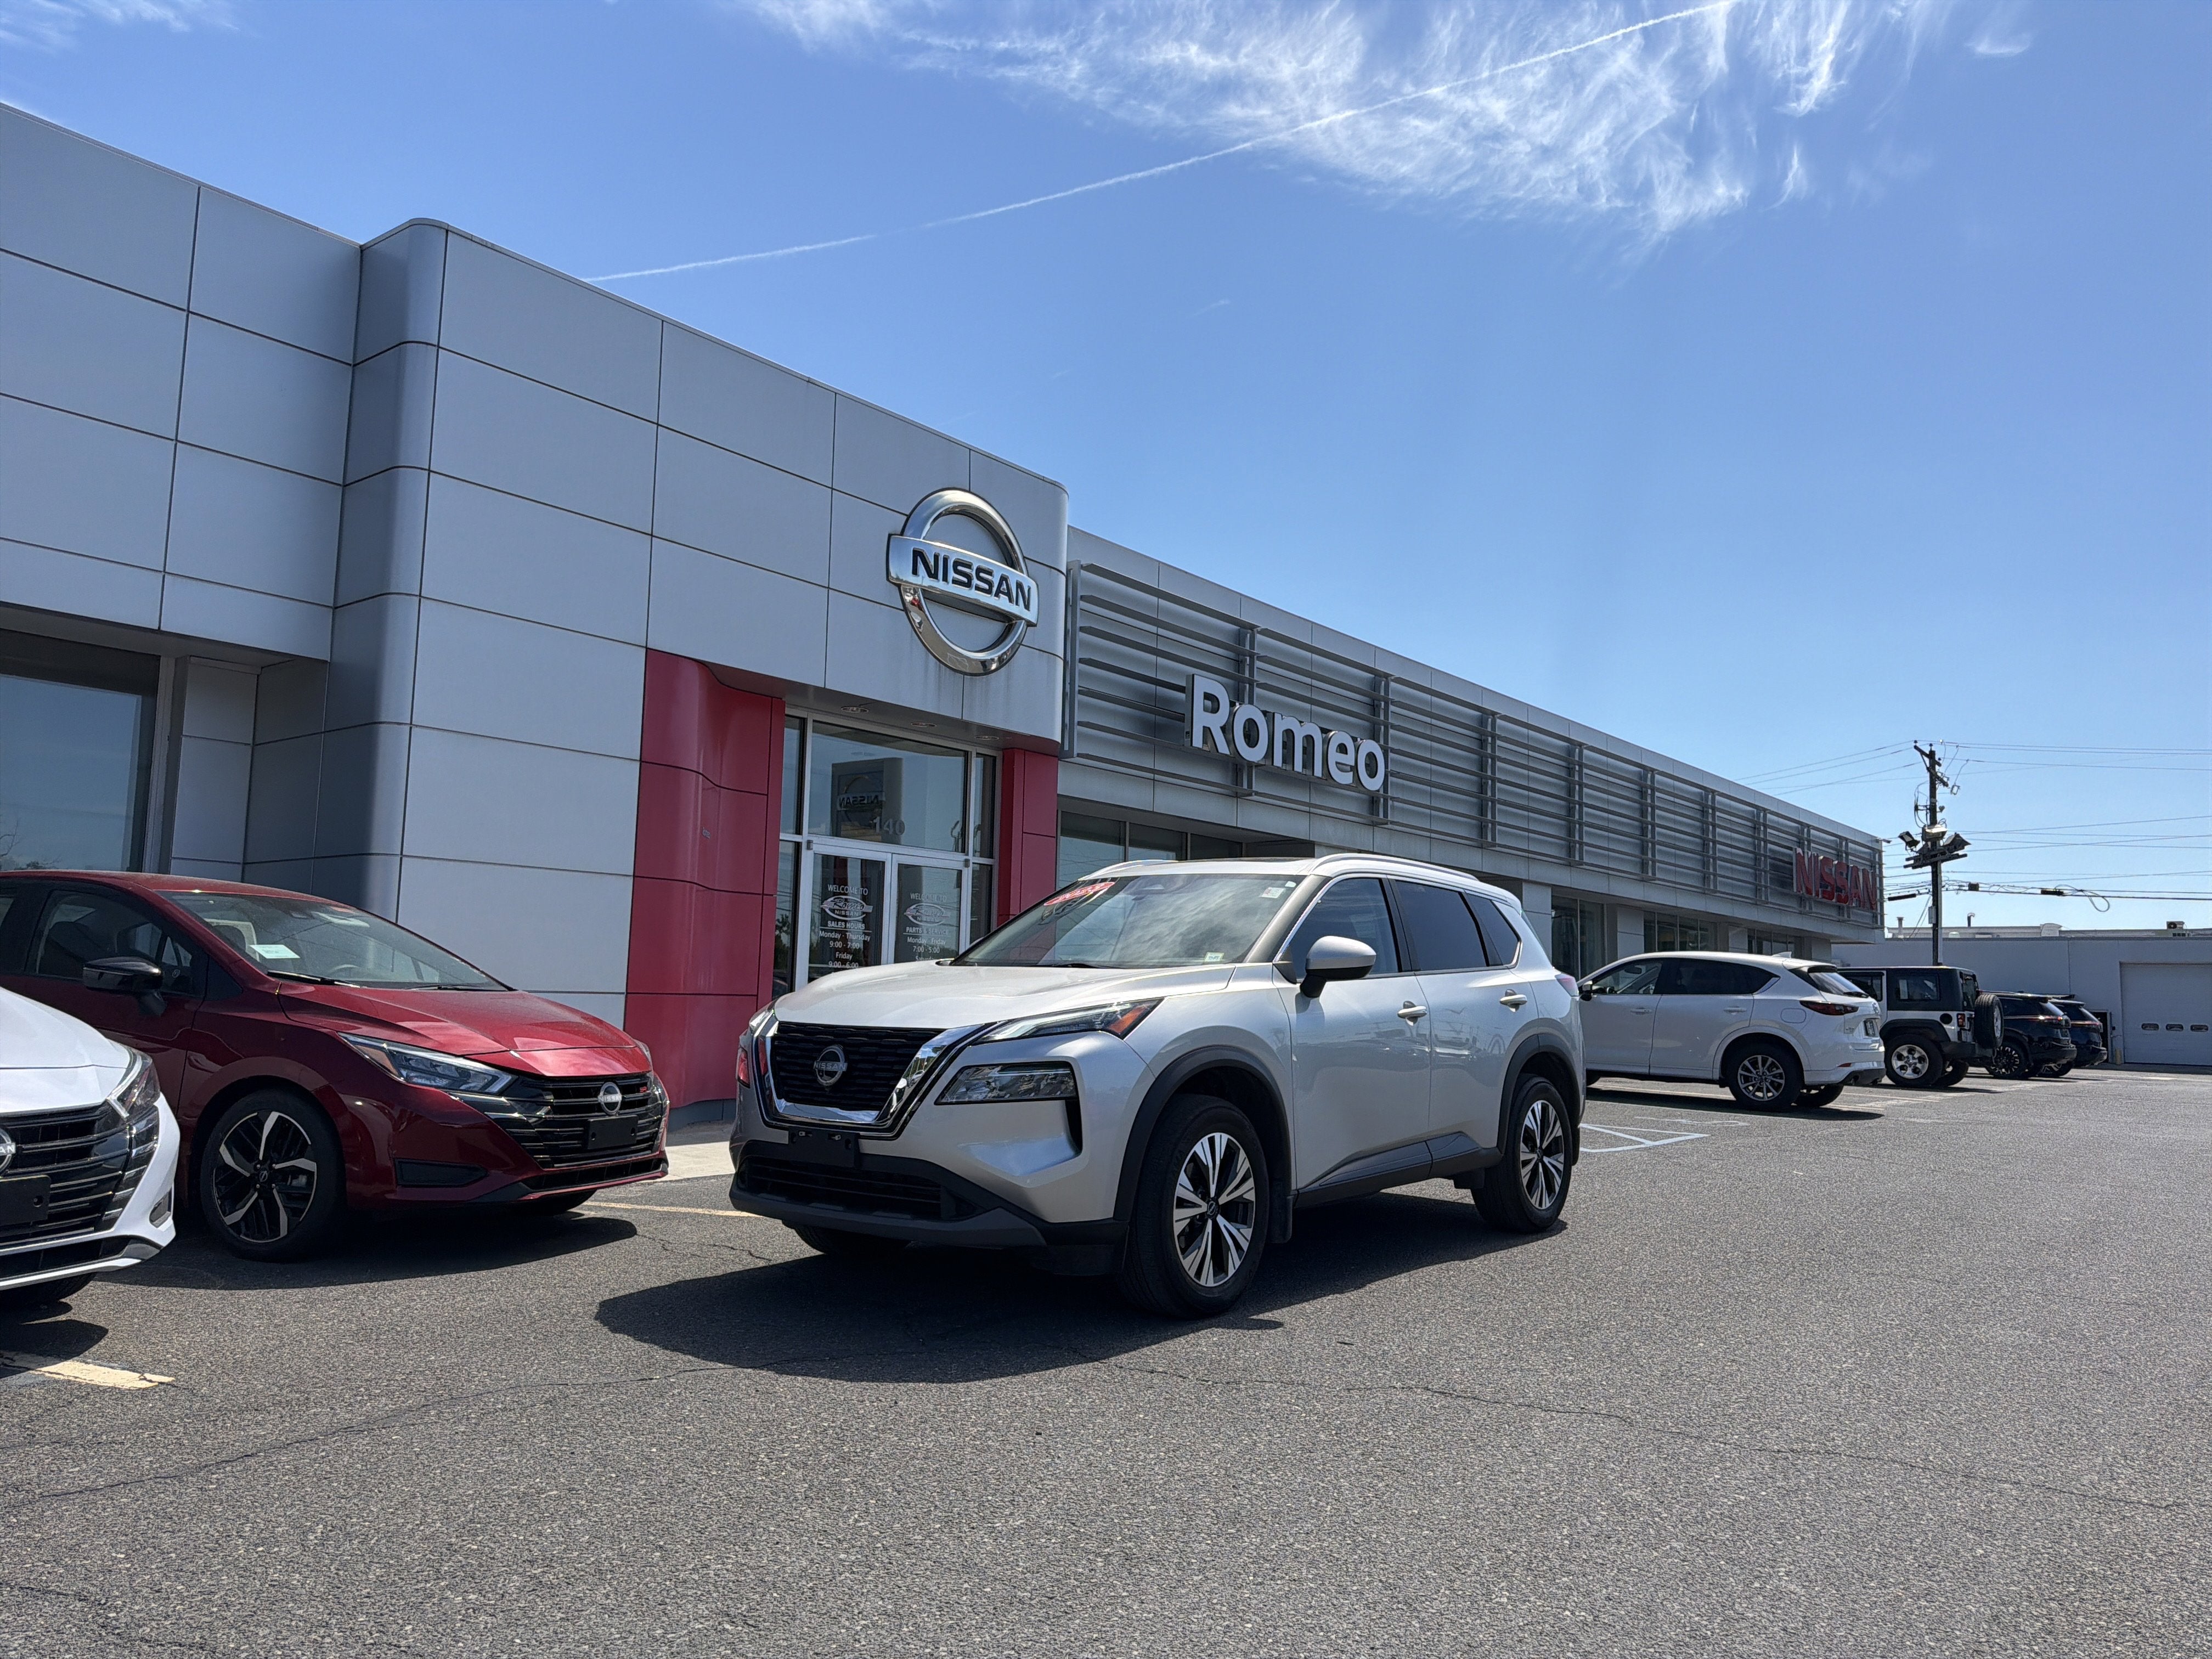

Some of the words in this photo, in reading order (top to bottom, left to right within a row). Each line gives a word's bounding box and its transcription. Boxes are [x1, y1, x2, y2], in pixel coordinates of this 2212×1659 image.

[911, 547, 1031, 612] NISSAN
[1189, 673, 1386, 791] Romeo
[872, 816, 905, 836] 140
[1793, 847, 1877, 910] NISSAN
[828, 884, 859, 894] WELCOME
[832, 897, 865, 911] Romeo
[819, 930, 841, 939] Monday
[846, 932, 871, 941] Thursday
[907, 936, 927, 945] Monday
[813, 1060, 846, 1070] NISSAN
